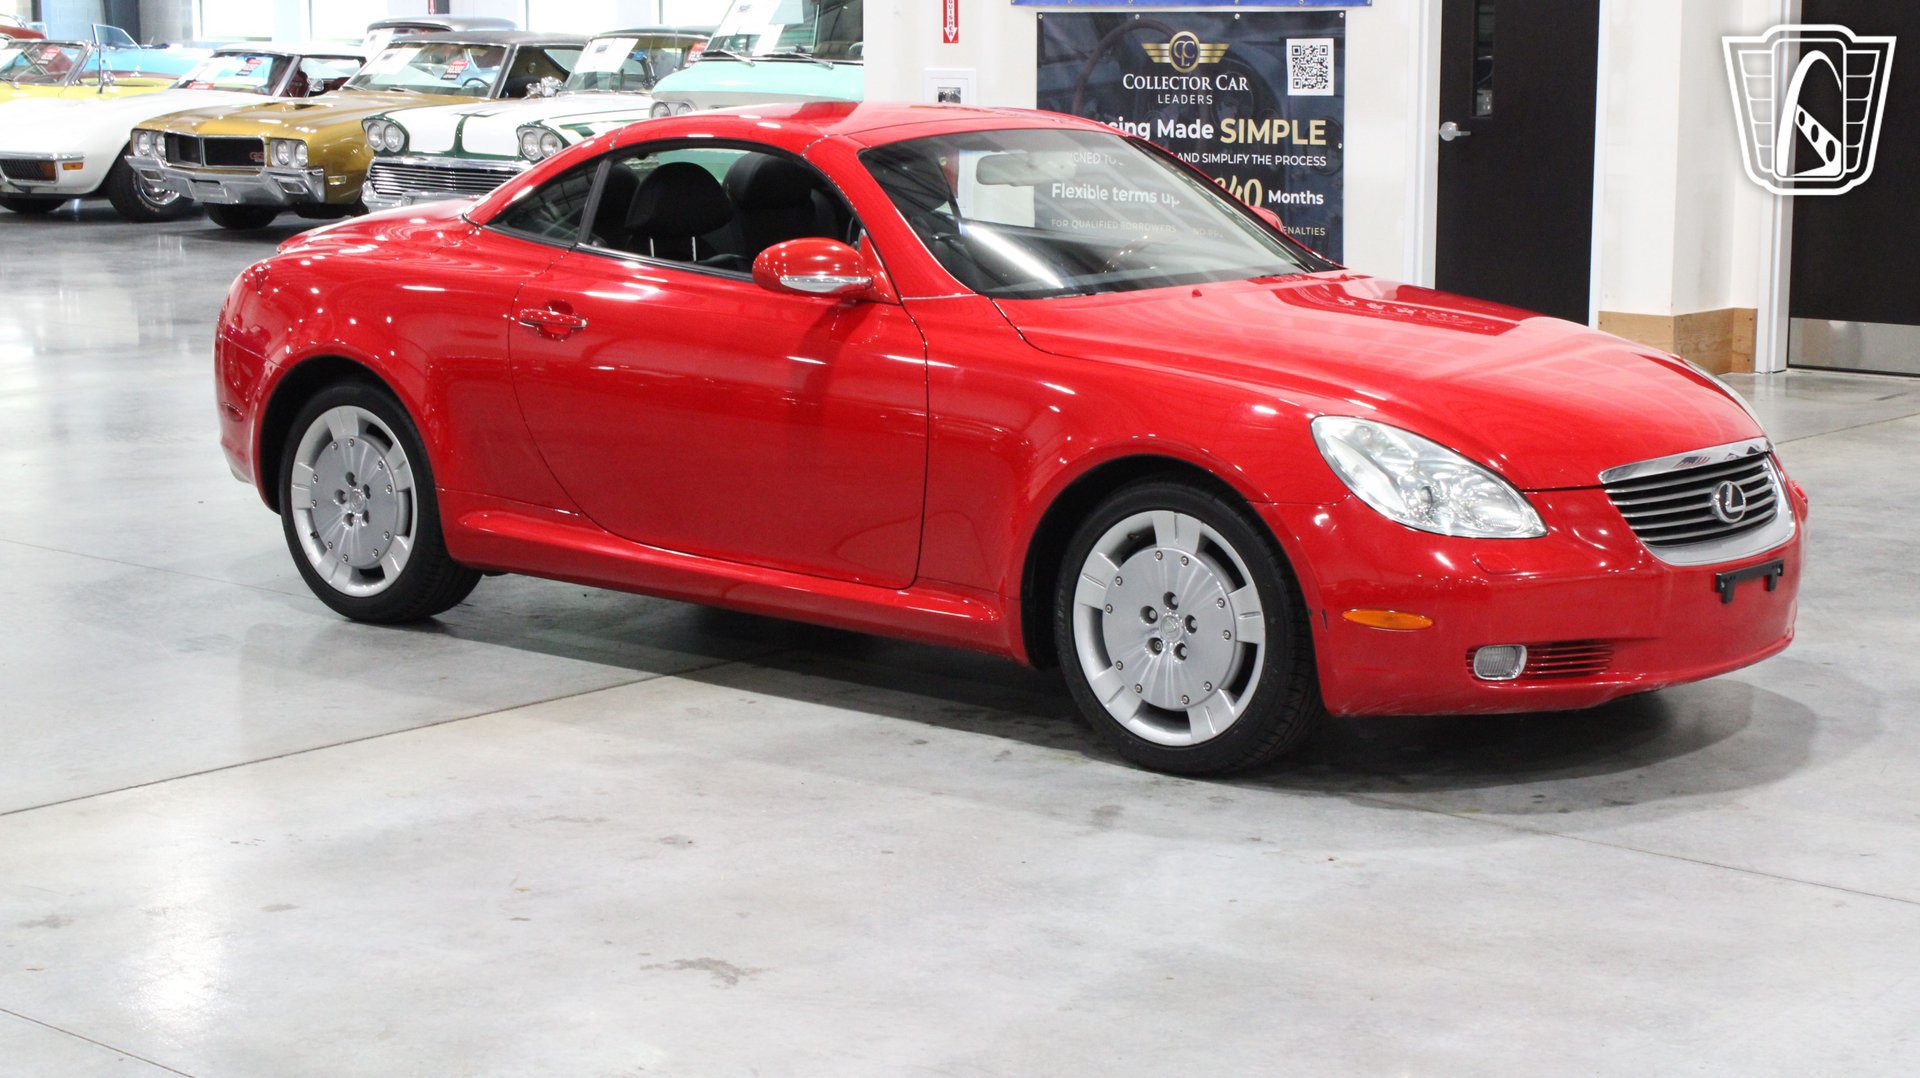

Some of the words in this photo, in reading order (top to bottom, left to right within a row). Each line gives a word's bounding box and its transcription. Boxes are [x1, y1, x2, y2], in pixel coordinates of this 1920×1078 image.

[1123, 73, 1212, 91] COLLECTOR
[1215, 74, 1249, 91] CAR
[1157, 94, 1213, 105] LEADERS
[1157, 119, 1214, 140] Made
[1220, 118, 1327, 146] SIMPLE
[1177, 152, 1200, 163] AND
[1202, 152, 1250, 165] SIMPLIFY
[1251, 154, 1272, 166] THE
[1275, 155, 1327, 167] PROCESS
[1051, 182, 1109, 201] Flexible
[1112, 187, 1158, 203] terms
[1268, 189, 1324, 205] Months
[1051, 218, 1069, 228] FOR
[1071, 218, 1119, 230] QUALIFIED
